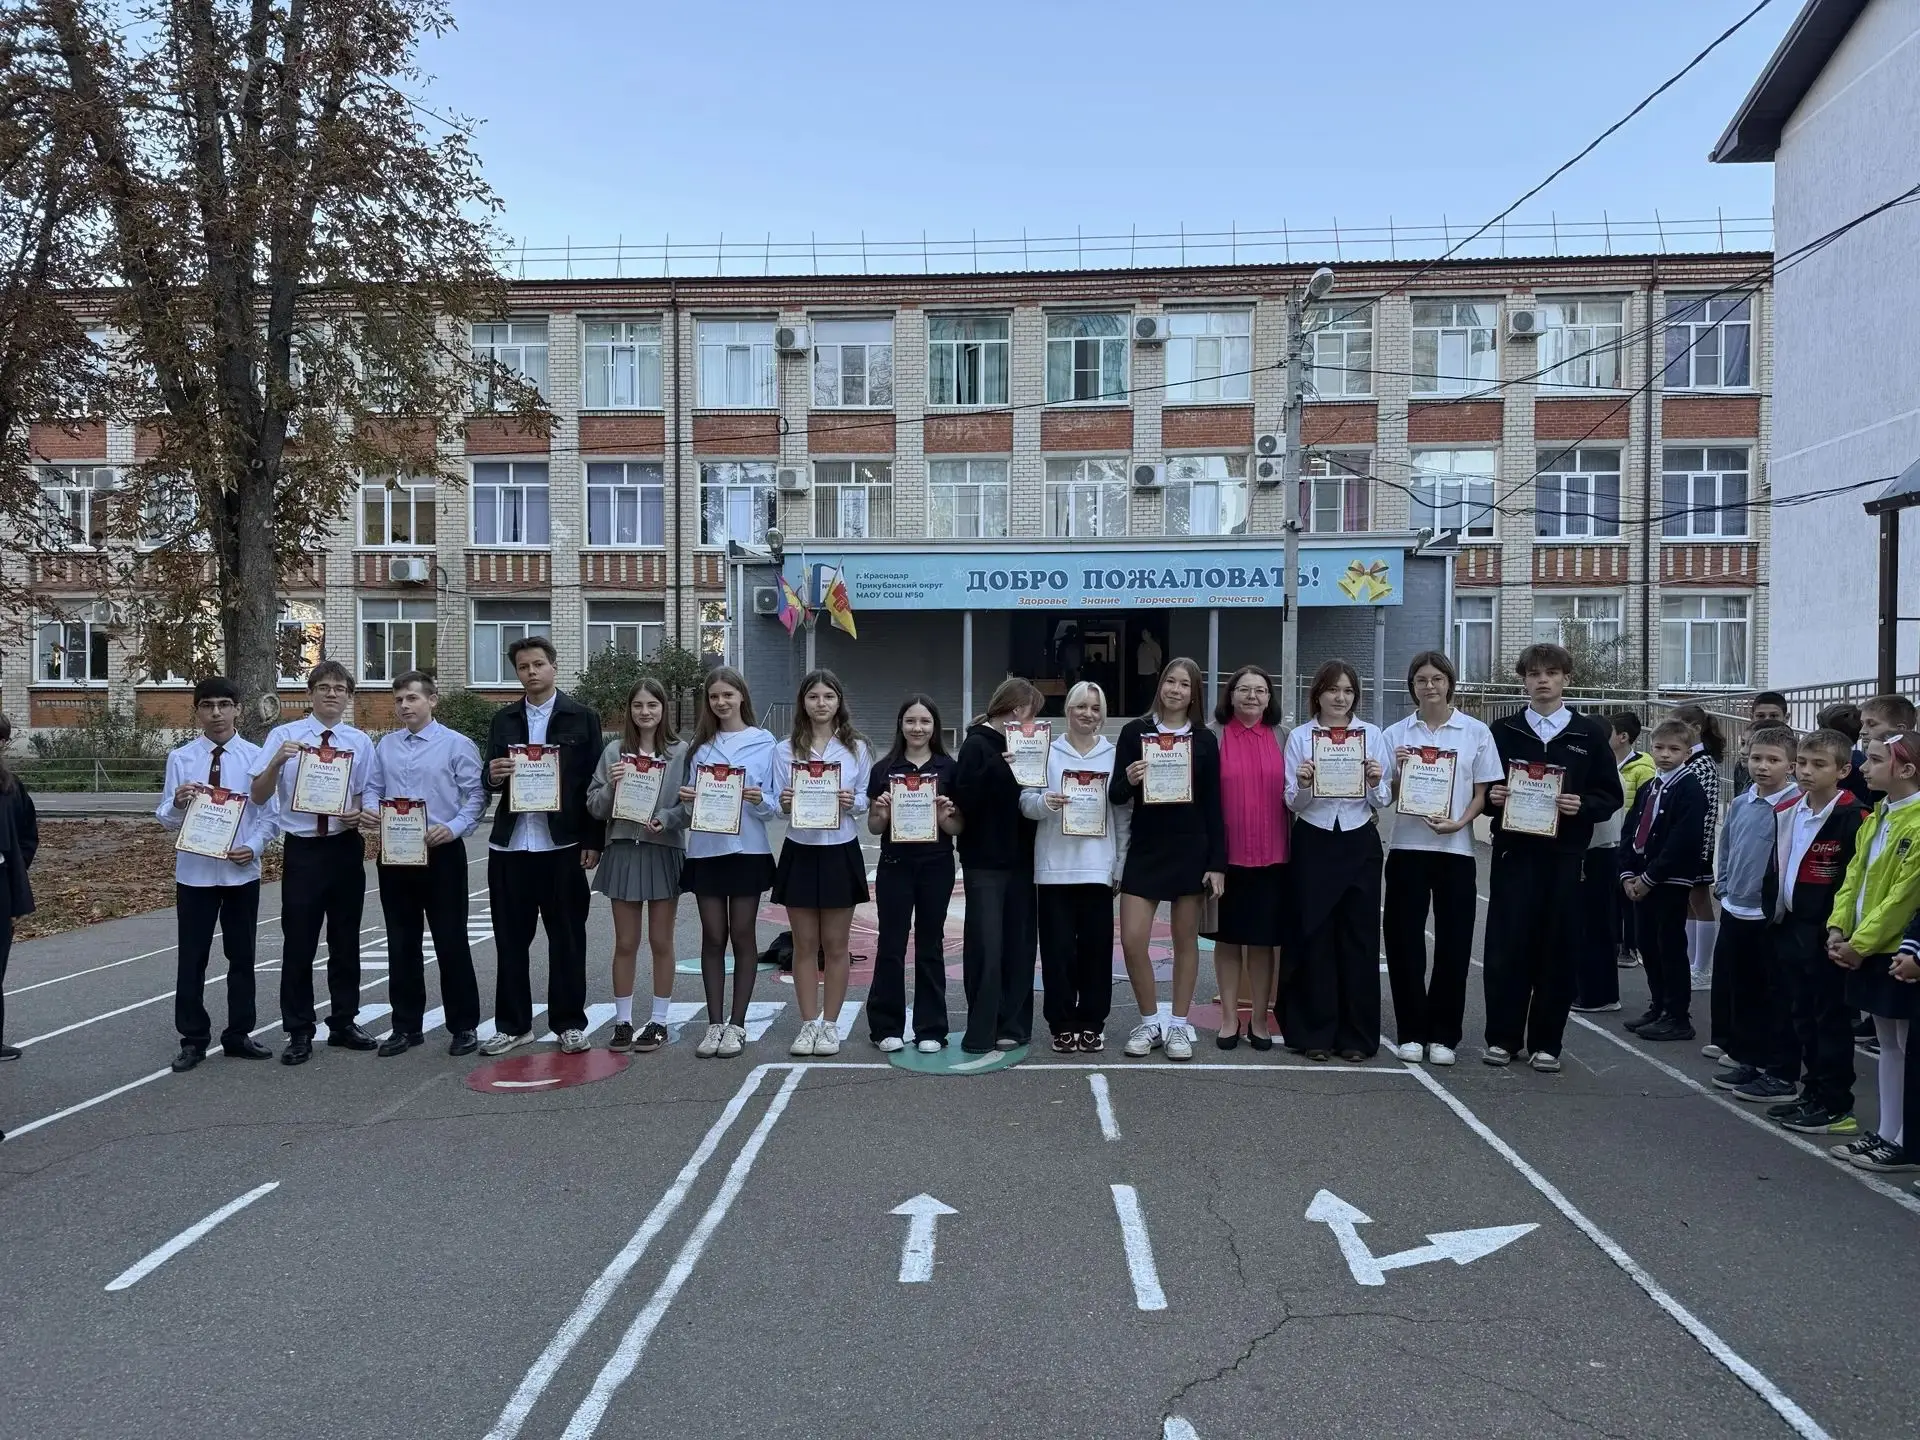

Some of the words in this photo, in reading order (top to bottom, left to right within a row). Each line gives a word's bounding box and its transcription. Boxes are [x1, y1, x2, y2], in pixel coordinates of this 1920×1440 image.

[966, 570, 1069, 592] ДОБРО
[1018, 597, 1068, 606] Здоровье
[1081, 597, 1120, 605] Знание
[1134, 596, 1195, 606] Творчество
[1208, 595, 1265, 604] Отечество
[310, 763, 341, 773] ГРАМОТА
[1412, 764, 1445, 773] ГРАМОТА
[627, 772, 655, 782] ГРАМОТА
[705, 781, 735, 790] ГРАМОТА
[1518, 779, 1552, 790] ГРАМОТА
[200, 803, 232, 815] ГРАМОТА
